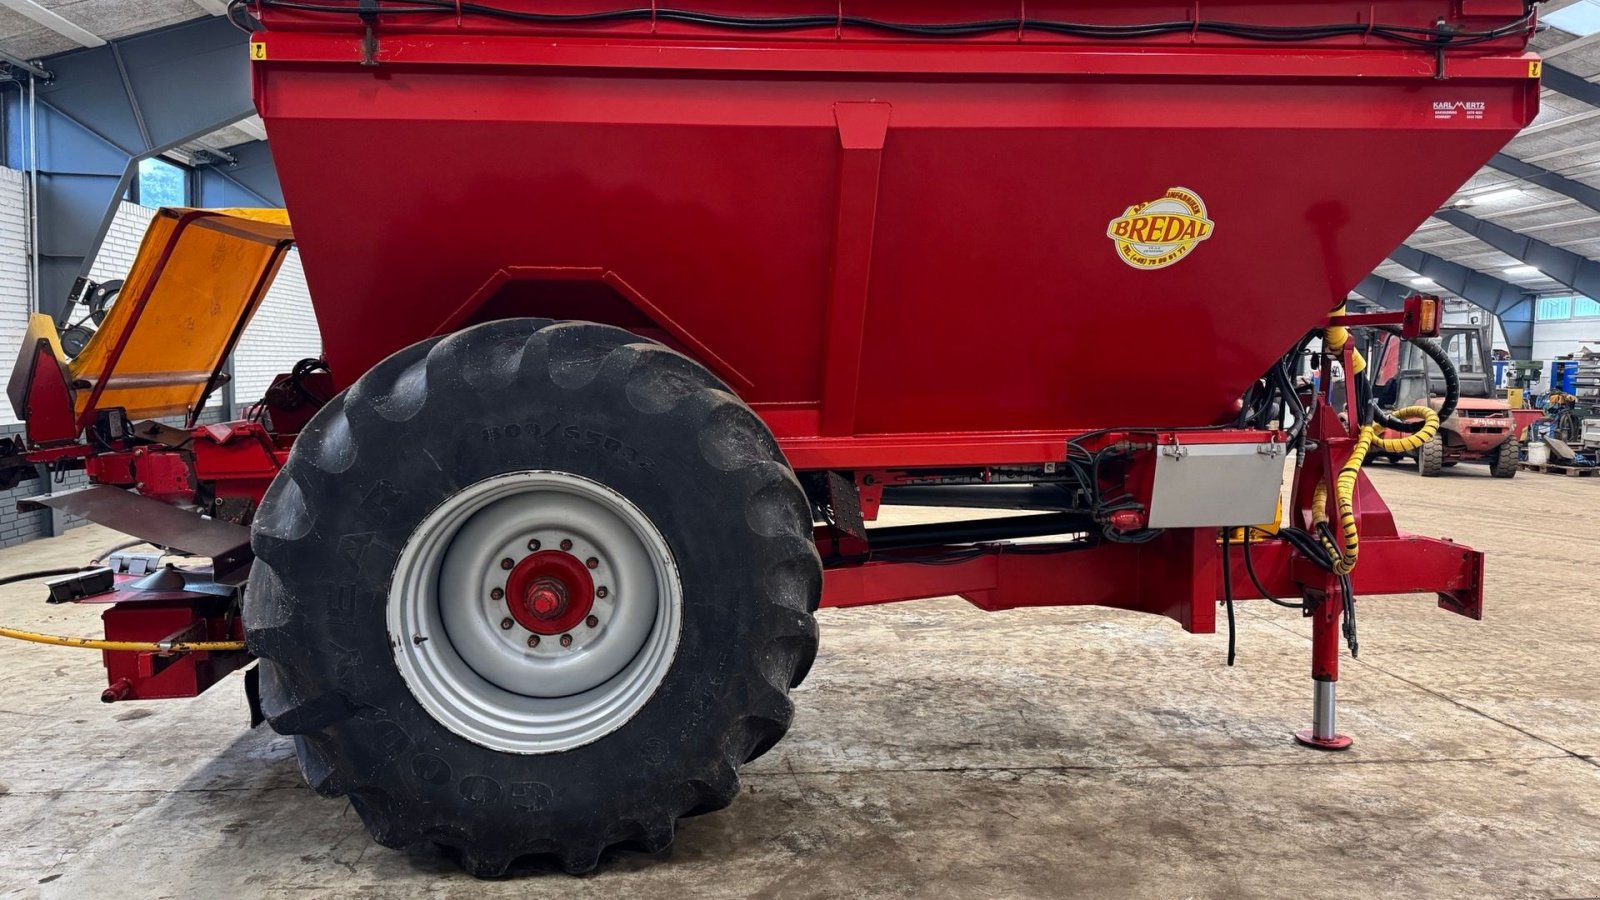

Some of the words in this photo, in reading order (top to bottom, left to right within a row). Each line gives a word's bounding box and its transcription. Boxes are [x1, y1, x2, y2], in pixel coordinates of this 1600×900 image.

[1433, 102, 1453, 110] KARL
[1114, 216, 1207, 243] BREDAL
[1177, 245, 1186, 255] 77
